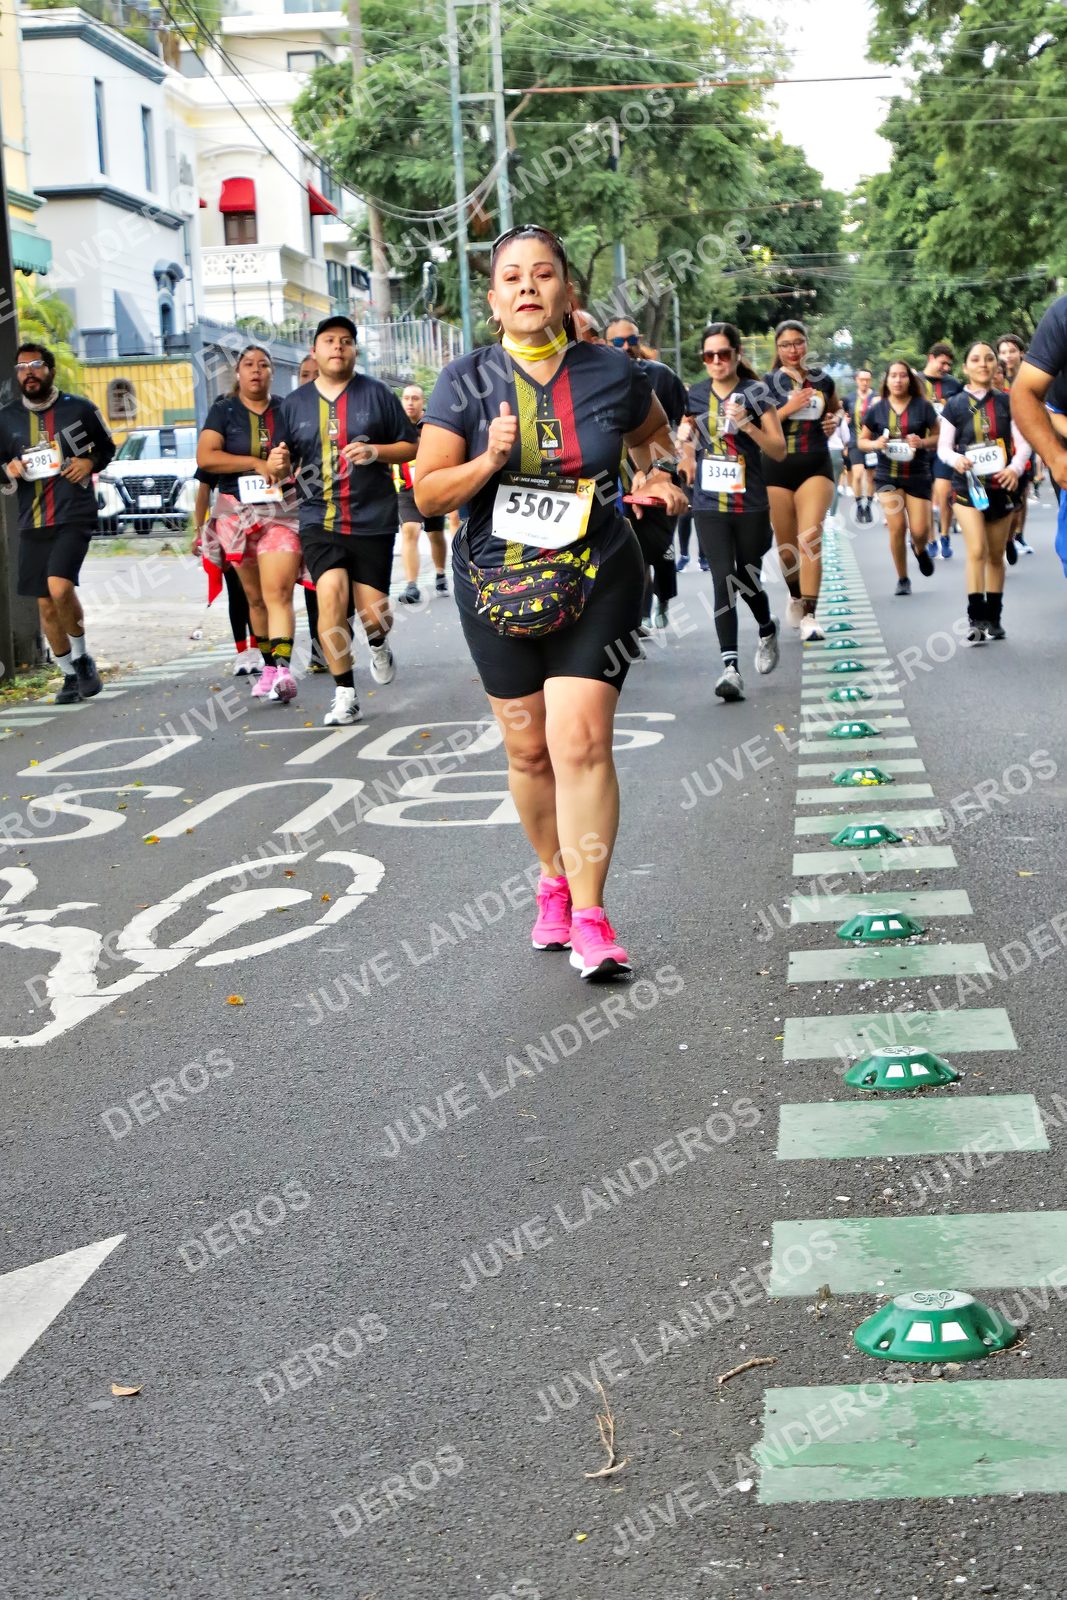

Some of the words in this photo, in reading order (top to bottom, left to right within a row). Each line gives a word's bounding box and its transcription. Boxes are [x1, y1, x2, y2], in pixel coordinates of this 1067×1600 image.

[972, 449, 998, 465] 2665
[708, 465, 737, 479] 3344
[578, 484, 590, 494] 5K
[505, 492, 571, 523] 5507
